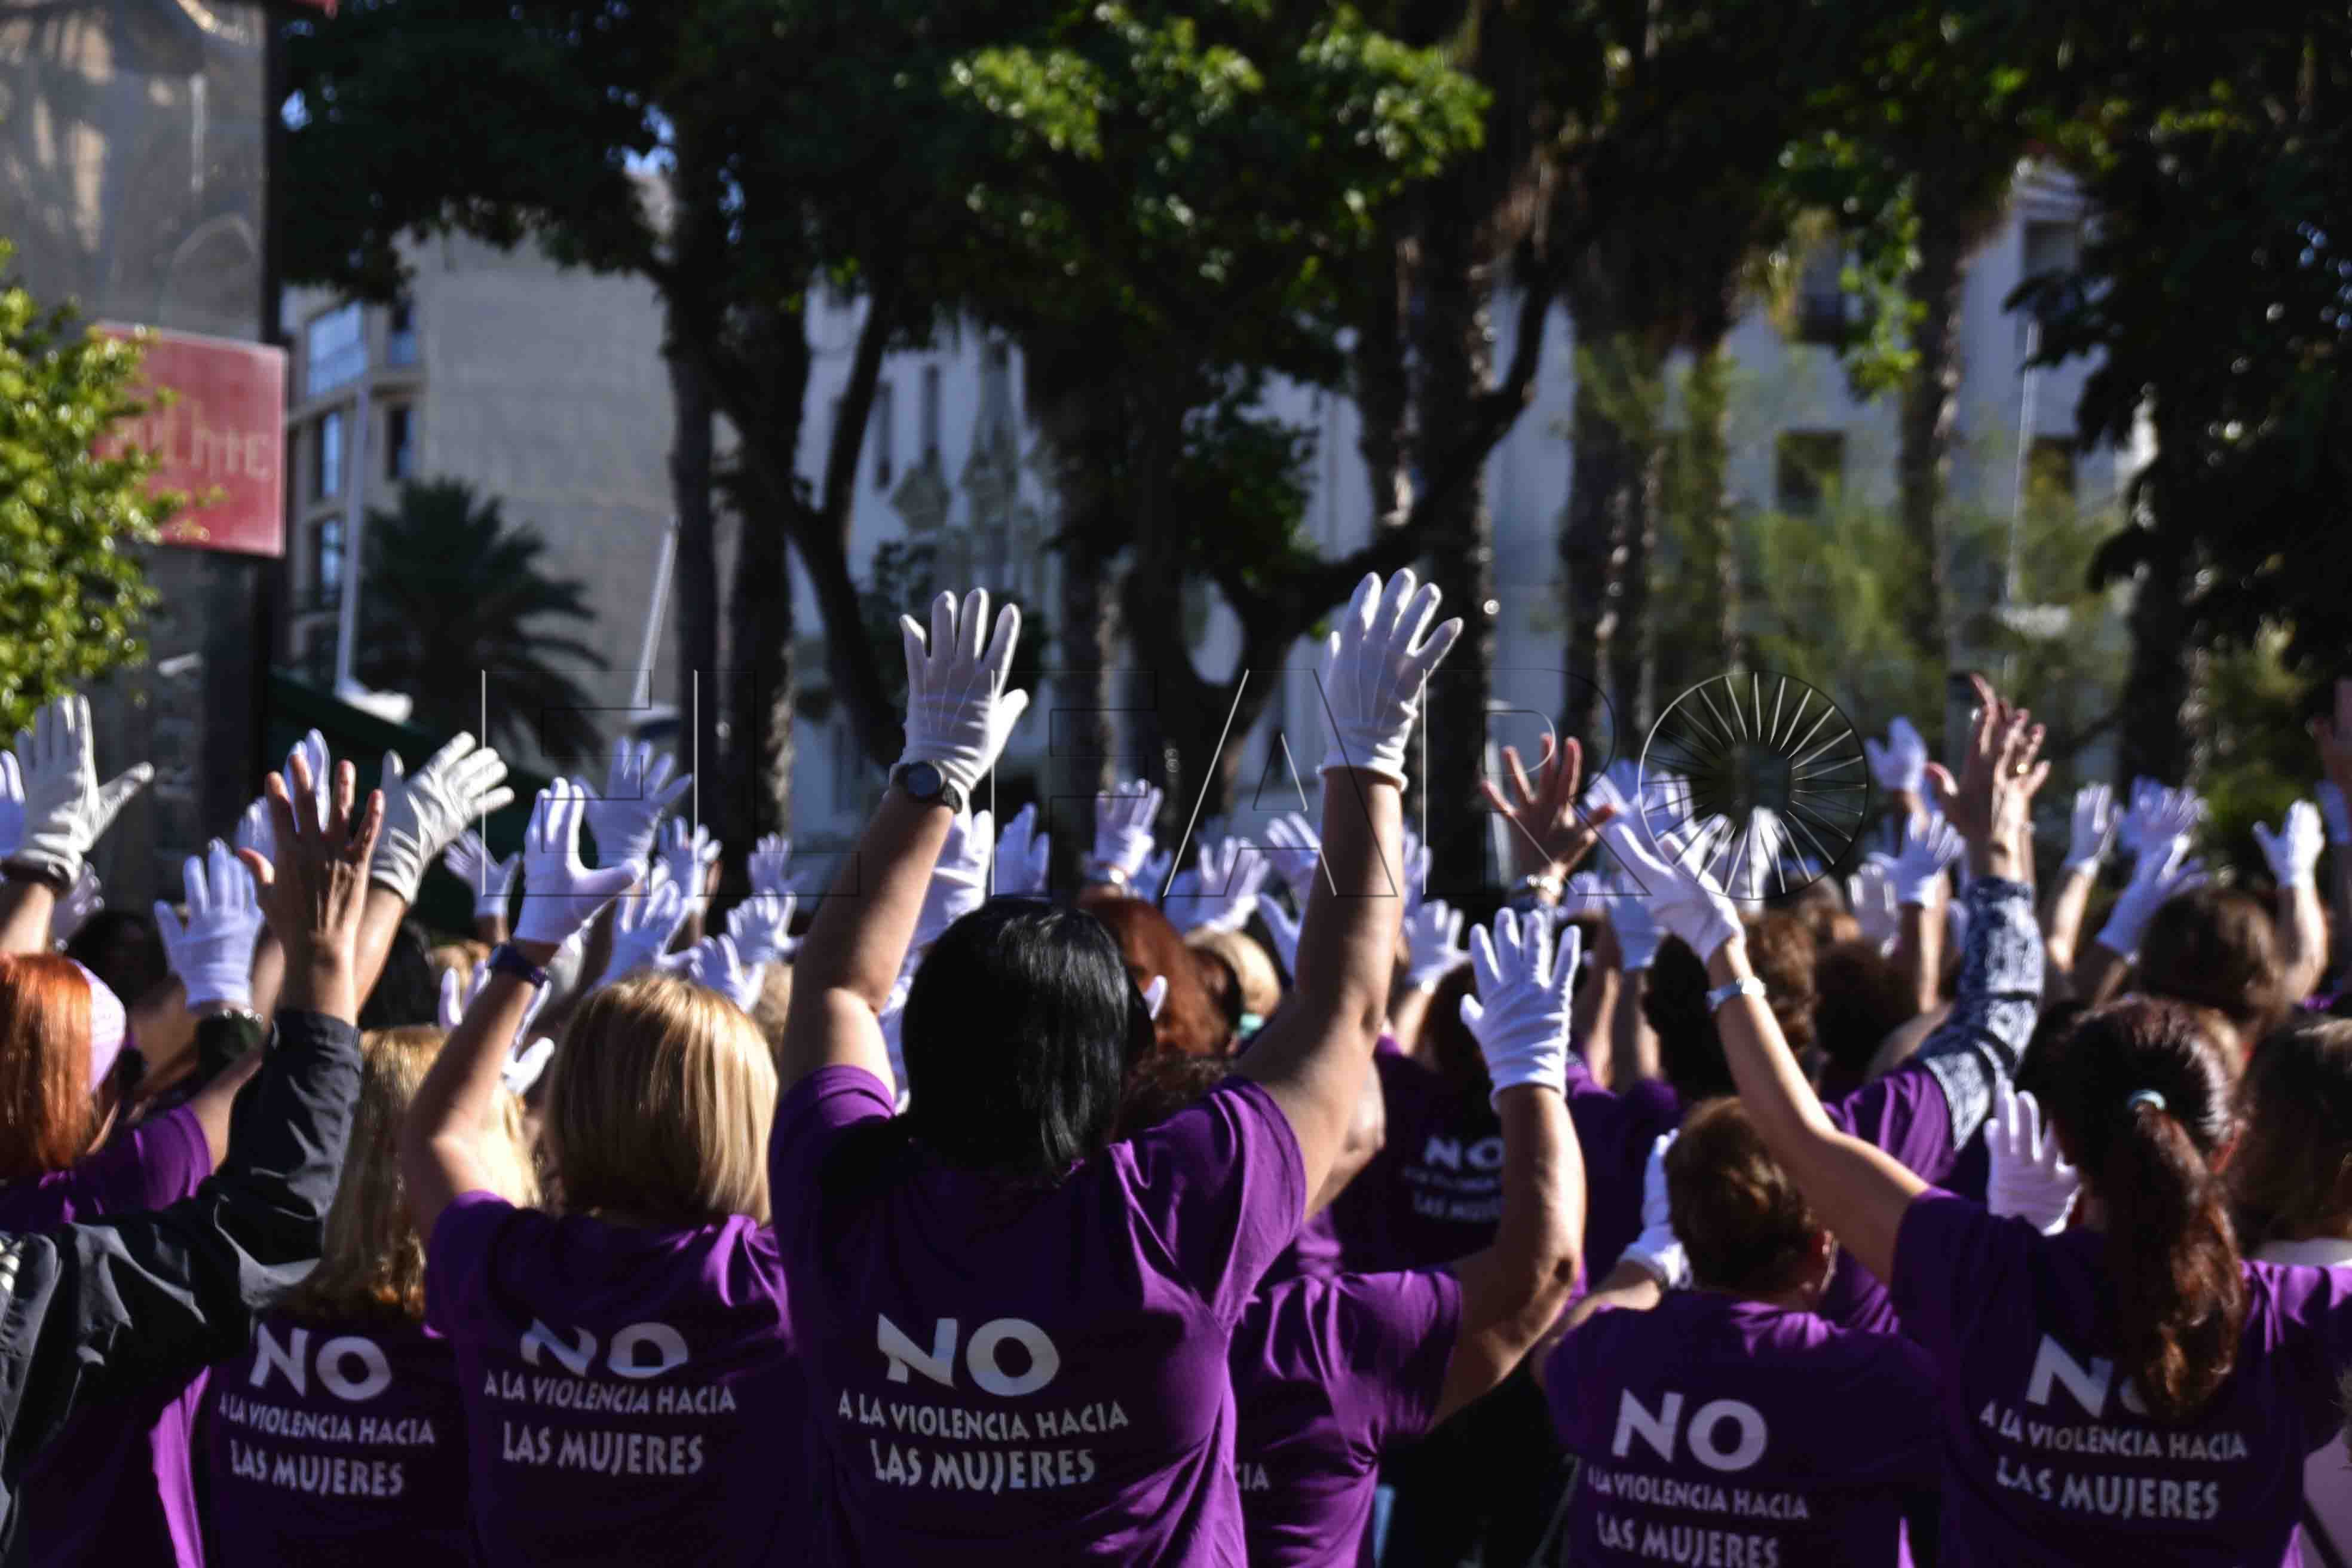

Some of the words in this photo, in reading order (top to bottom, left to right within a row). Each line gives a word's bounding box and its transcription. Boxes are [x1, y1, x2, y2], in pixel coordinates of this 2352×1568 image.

[1424, 1137, 1502, 1171] NO
[249, 1322, 392, 1401] NO
[520, 1317, 689, 1379] NO
[877, 1313, 1061, 1396] NO
[228, 1393, 246, 1424] LA
[248, 1402, 353, 1444] VIOLENCIA
[358, 1416, 436, 1446] HACIA
[485, 1369, 497, 1396] A
[501, 1371, 525, 1402] LA
[532, 1378, 650, 1413] VIOLENCIA
[656, 1383, 736, 1414] HACIA
[838, 1389, 852, 1420] A
[858, 1392, 886, 1428] LA
[890, 1402, 1030, 1441] VIOLENCIA
[1036, 1400, 1129, 1436] HACIA
[503, 1422, 551, 1465] LAS
[558, 1432, 704, 1476] MUJERES
[1612, 1387, 1768, 1471] NO
[1979, 1399, 1996, 1427] A
[1998, 1407, 2022, 1442] LA
[2028, 1421, 2163, 1459] VIOLENCIA
[2169, 1432, 2249, 1460] HACIA
[229, 1438, 268, 1482] LAS
[272, 1452, 405, 1497] MUJERES
[870, 1438, 922, 1486] LAS
[930, 1449, 1095, 1494] MUJERES
[1996, 1454, 2054, 1500] LAS
[2060, 1472, 2219, 1521] MUJERES
[1613, 1471, 1727, 1513] VIOLENCIA
[1734, 1489, 1809, 1520] HACIA
[1596, 1510, 1635, 1552] LAS
[1641, 1523, 1780, 1568] MUJERES
